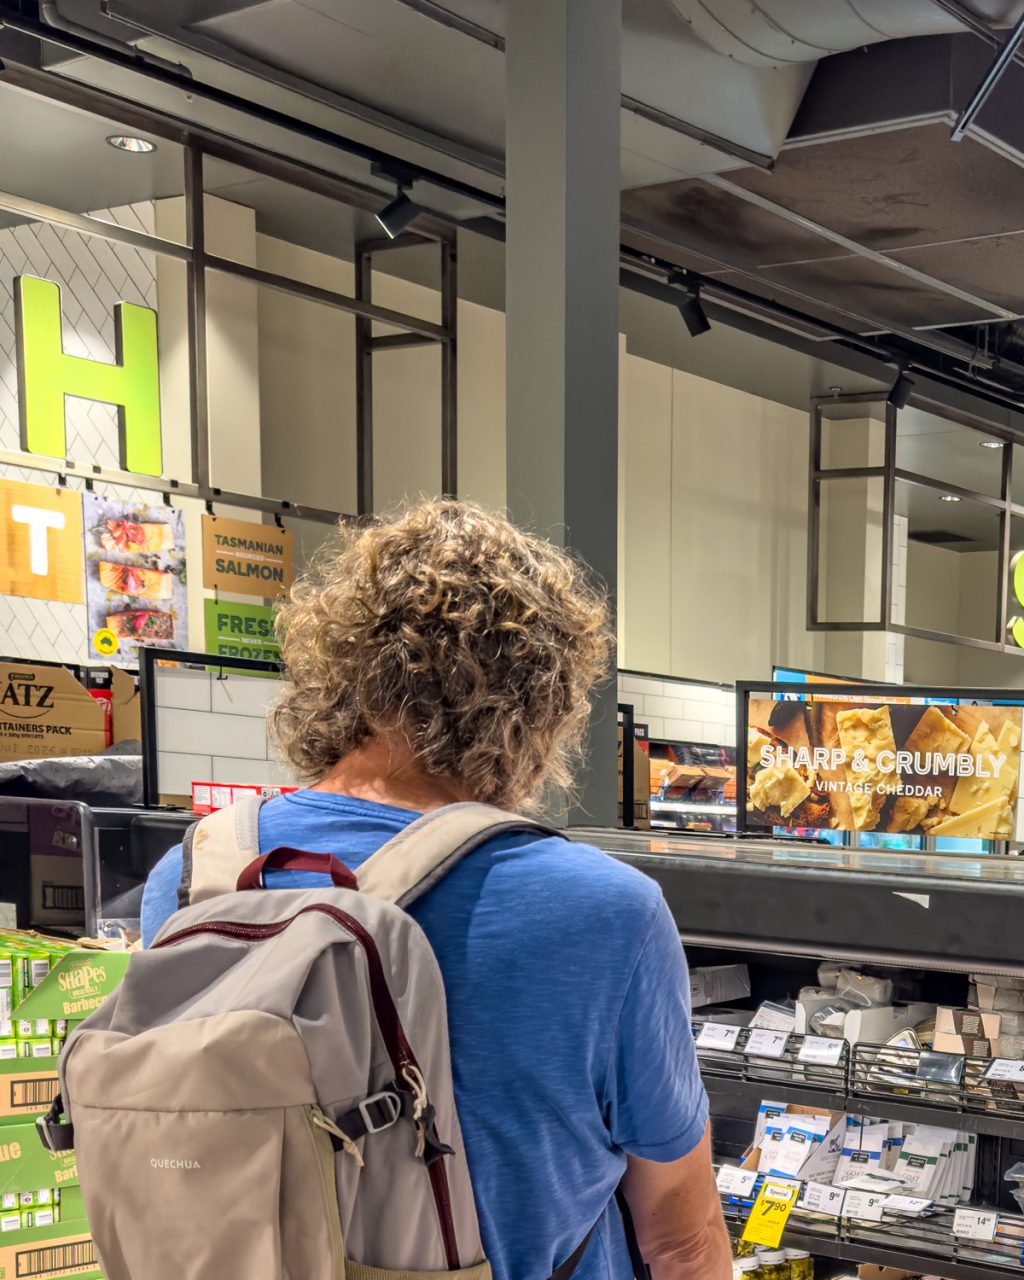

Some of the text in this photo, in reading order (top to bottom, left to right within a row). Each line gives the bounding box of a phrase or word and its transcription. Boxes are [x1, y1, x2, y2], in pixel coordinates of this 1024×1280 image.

[214, 534, 284, 555] TASMANIAN
[215, 558, 284, 582] SALMON
[217, 613, 275, 637] FRES
[0, 682, 54, 709] ATZ
[0, 722, 72, 735] TAINERS PACK
[760, 744, 1007, 778] SHARP & CRUMBLY
[816, 780, 942, 797] VINTAGE CHEDDAR
[151, 1158, 201, 1170] QUECHUA
[769, 1188, 789, 1198] Special
